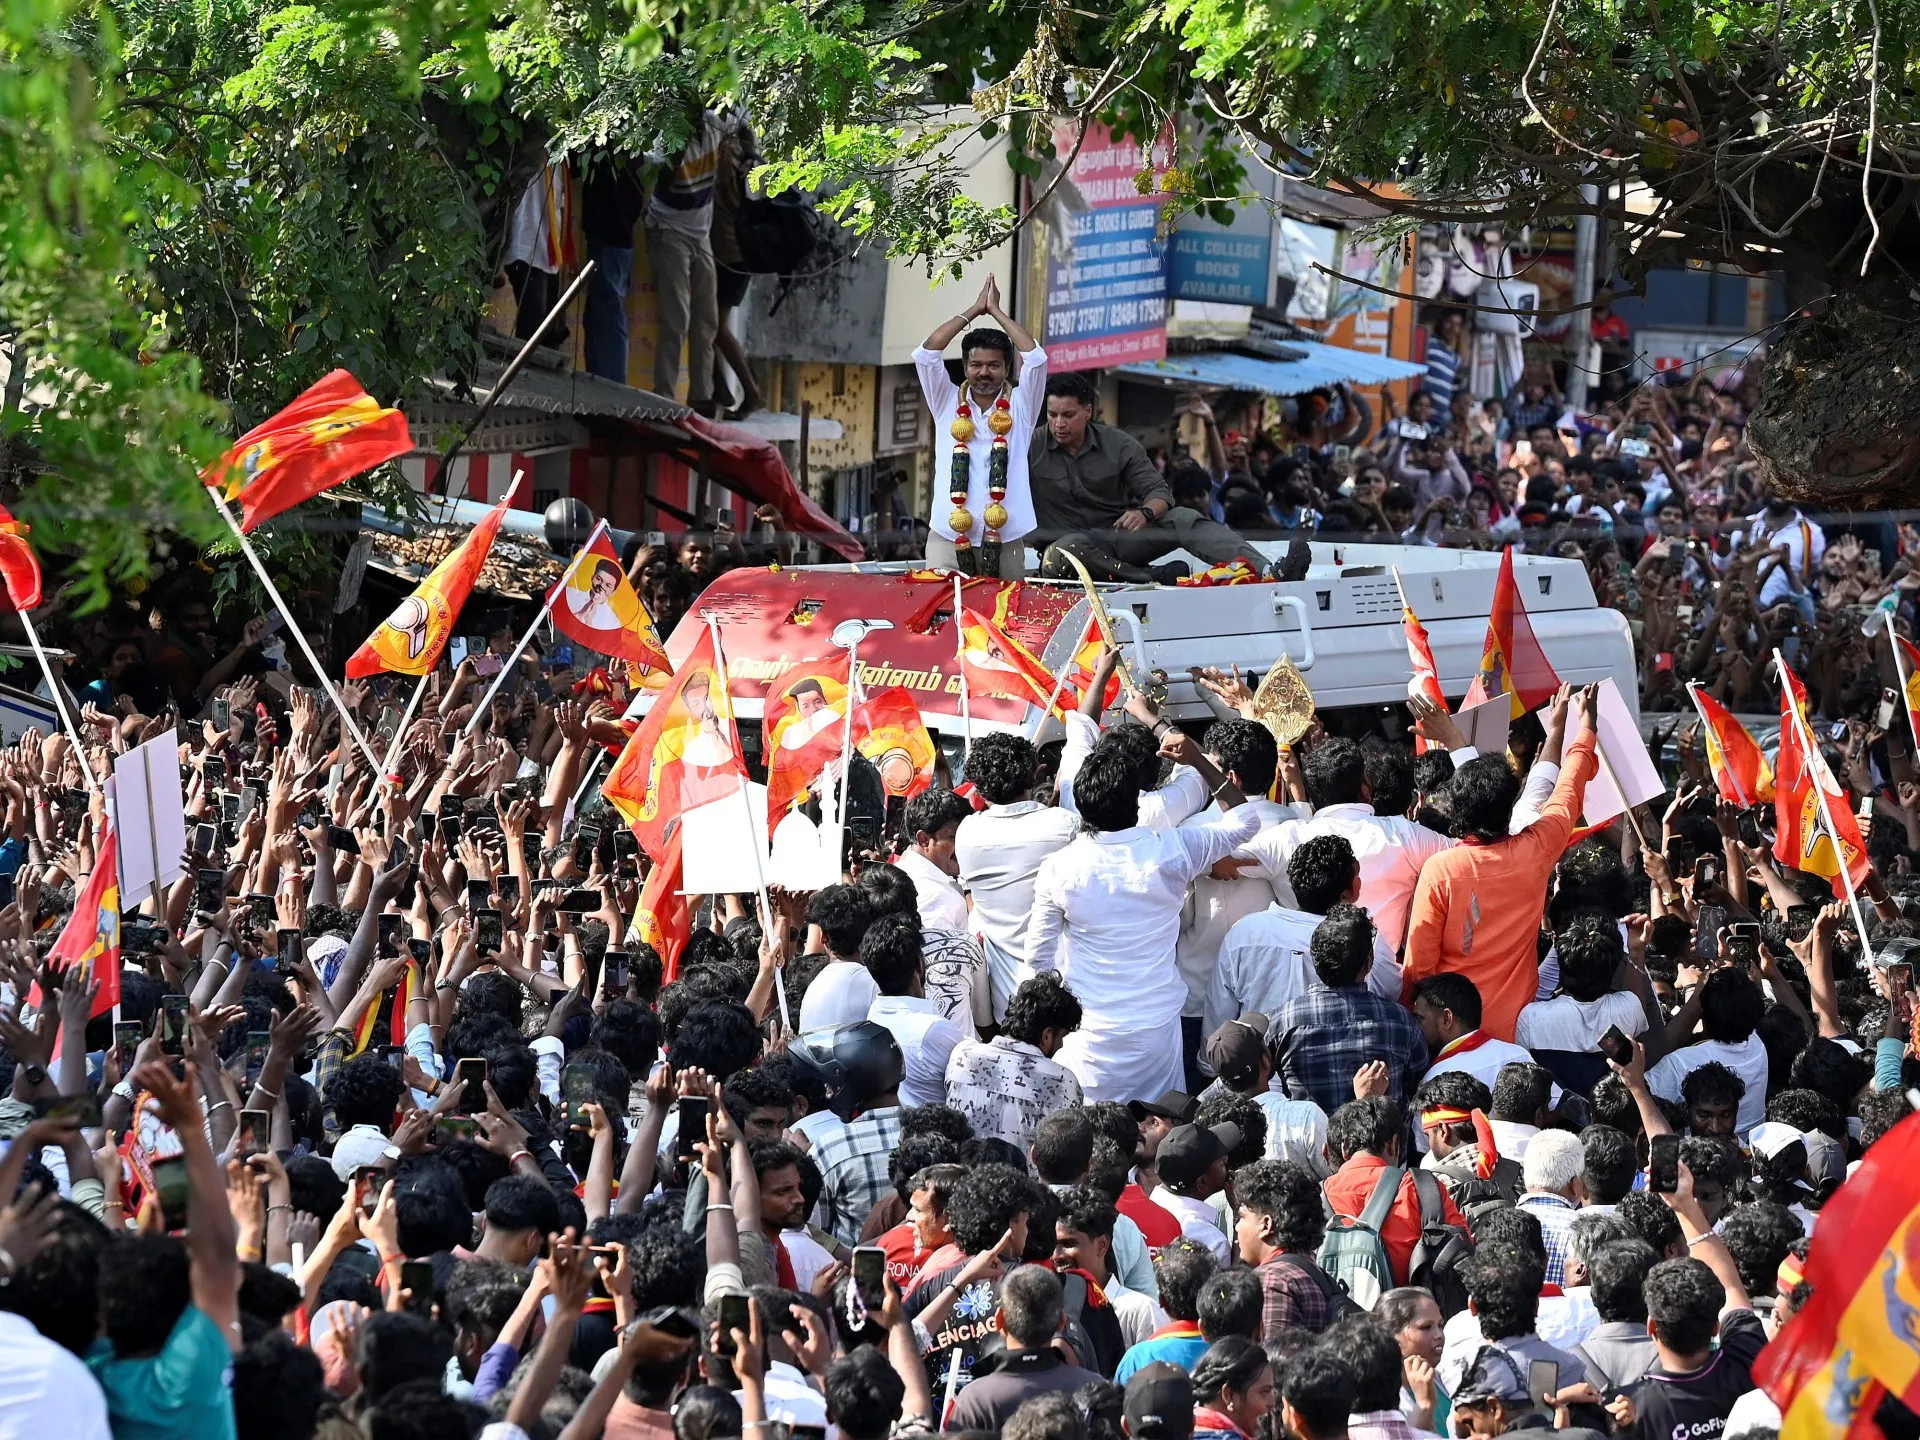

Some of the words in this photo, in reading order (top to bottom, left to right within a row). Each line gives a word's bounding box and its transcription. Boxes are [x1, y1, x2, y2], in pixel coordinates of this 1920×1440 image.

[1094, 212, 1120, 234] BOOKS
[1128, 209, 1154, 231] GUIDES
[1176, 239, 1199, 254] ALL
[1203, 240, 1261, 259] COLLEGE
[1194, 260, 1240, 278] BOOKS
[1180, 279, 1252, 298] AVAILABLE
[1048, 309, 1076, 337] 97907
